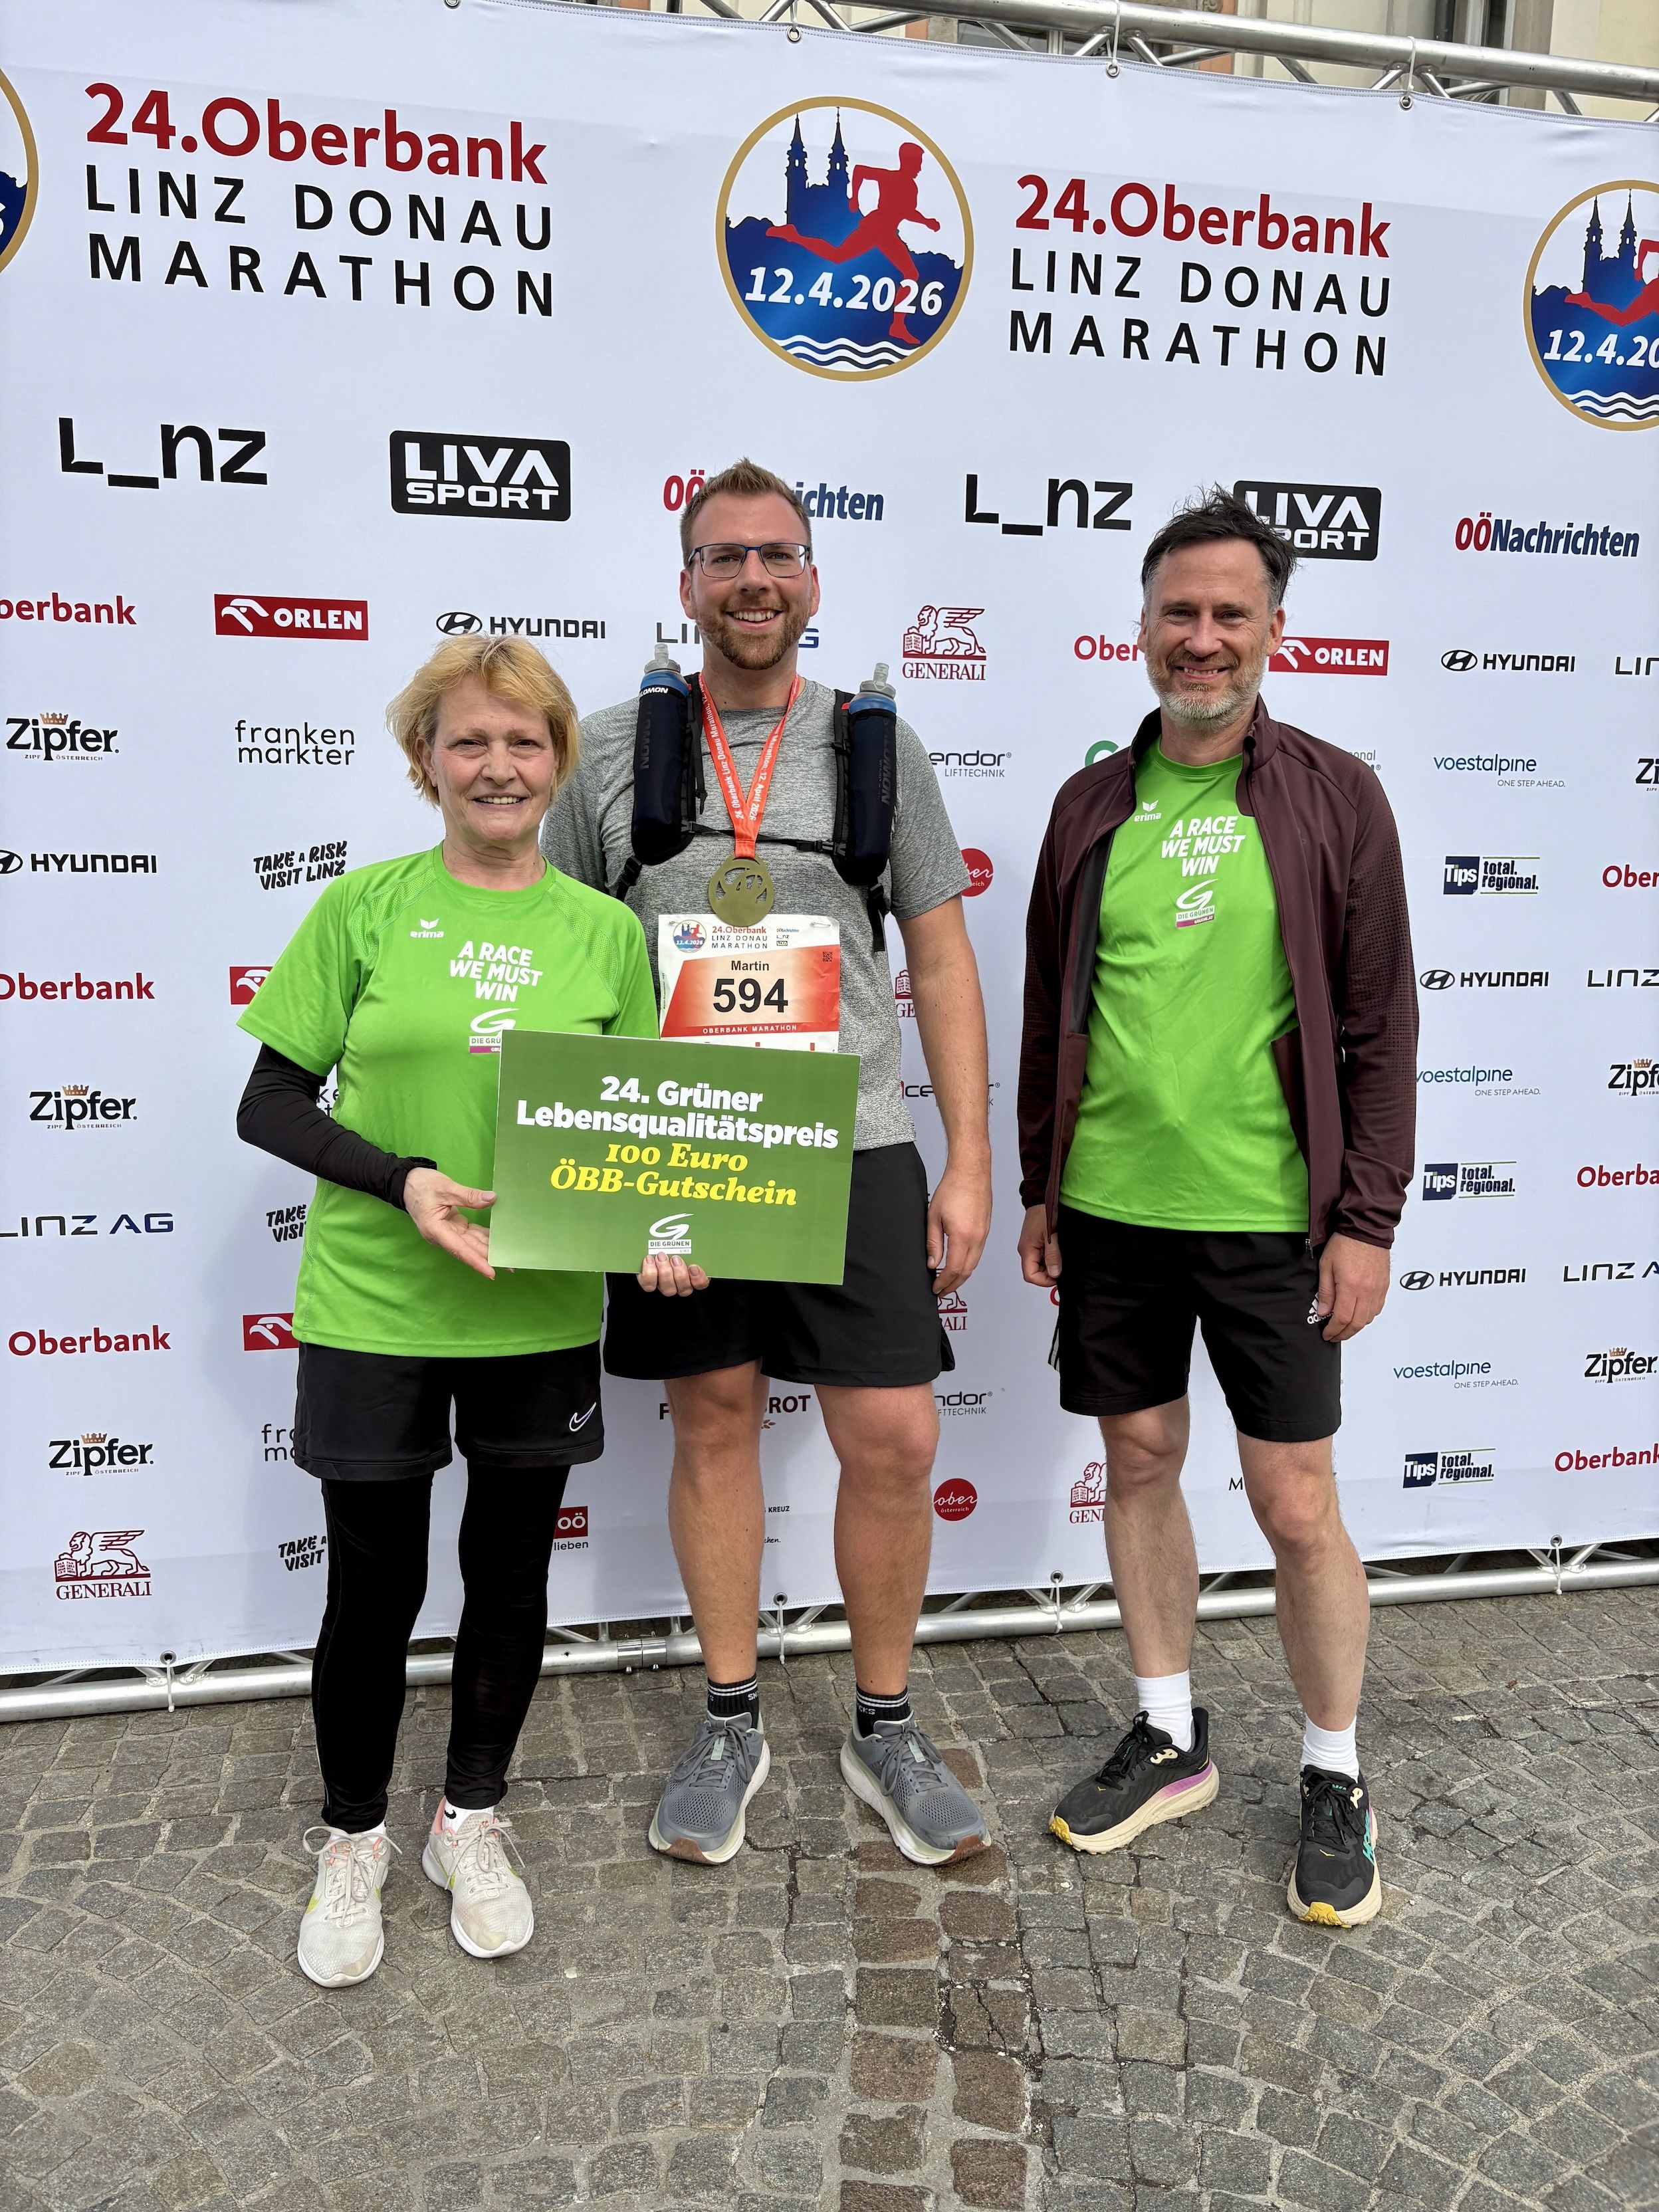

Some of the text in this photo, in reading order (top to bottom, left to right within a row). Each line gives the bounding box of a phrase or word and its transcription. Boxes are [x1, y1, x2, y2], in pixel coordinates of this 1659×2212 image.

[84, 82, 548, 185] 24.Oberbank
[86, 164, 552, 251] LINZ DONAU
[1015, 173, 1391, 258] 24.Oberbank
[88, 233, 554, 317] MARATHON
[1012, 248, 1390, 317] LINZ DONAU
[744, 267, 945, 316] 12.4.2026
[1009, 310, 1386, 376] MARATHON
[404, 442, 559, 487] LIVA
[407, 483, 559, 510] SPORT
[1244, 491, 1371, 530] LIVA
[1455, 512, 1640, 557] OÖNachrichten
[273, 608, 363, 630] ORLEN
[489, 617, 606, 639] HYUNDAI
[1314, 647, 1384, 667] ORLEN
[1482, 654, 1575, 672] HYUNDAI
[902, 662, 986, 681] GENERALI
[705, 703, 719, 738] Marathon,
[235, 720, 355, 745] franken
[238, 744, 355, 766] markter
[715, 738, 726, 760] Donau
[721, 760, 731, 775] Linz
[944, 768, 1005, 778] LIFTTECHNIK
[1433, 754, 1537, 776] voestalpine
[724, 776, 740, 808] Oberbank
[753, 784, 765, 802] April
[1133, 812, 1162, 822] erima
[1169, 816, 1238, 838] A RACE
[253, 840, 348, 874] TAKE A RISK
[1161, 834, 1246, 858] WE MUST
[31, 853, 158, 874] HYUNDAI
[1181, 855, 1220, 877] WIN
[1445, 860, 1517, 887] Tips total.
[260, 860, 346, 891] VISIT LINZ
[1482, 874, 1539, 891] regional.
[1190, 907, 1214, 918] GRÜNEN
[410, 930, 445, 939] erima
[457, 940, 534, 968] A RACE
[450, 959, 544, 987] WE MUST
[731, 960, 769, 971] Martin
[1460, 971, 1549, 988] HYUNDAI
[475, 980, 518, 1002] WIN
[713, 978, 788, 1013] 594
[600, 1075, 763, 1113] 24. Grüner
[516, 1099, 839, 1149] Lebensqualitätspreis
[605, 1142, 748, 1172] 100 Euro
[550, 1158, 797, 1206] ÖBB-Gutschein
[1423, 1164, 1495, 1192] Tips total.
[1460, 1177, 1515, 1194] regional.
[109, 1212, 174, 1235] AG
[267, 1204, 307, 1227] TAKE
[1439, 1268, 1526, 1287] HYUNDAI
[1563, 1262, 1634, 1282] LINZ
[9, 1325, 171, 1356] Oberbank
[1393, 1360, 1491, 1380] voestalpine
[1404, 1454, 1474, 1480] Tips total.
[1439, 1464, 1494, 1480] regional.
[933, 1493, 978, 1507] ober
[940, 1505, 970, 1514] österreich
[557, 1512, 586, 1530] OÖ
[278, 1535, 327, 1559] TAKE A
[553, 1540, 589, 1551] lieben
[284, 1550, 324, 1572] VISIT
[56, 1581, 152, 1600] GENERALI
